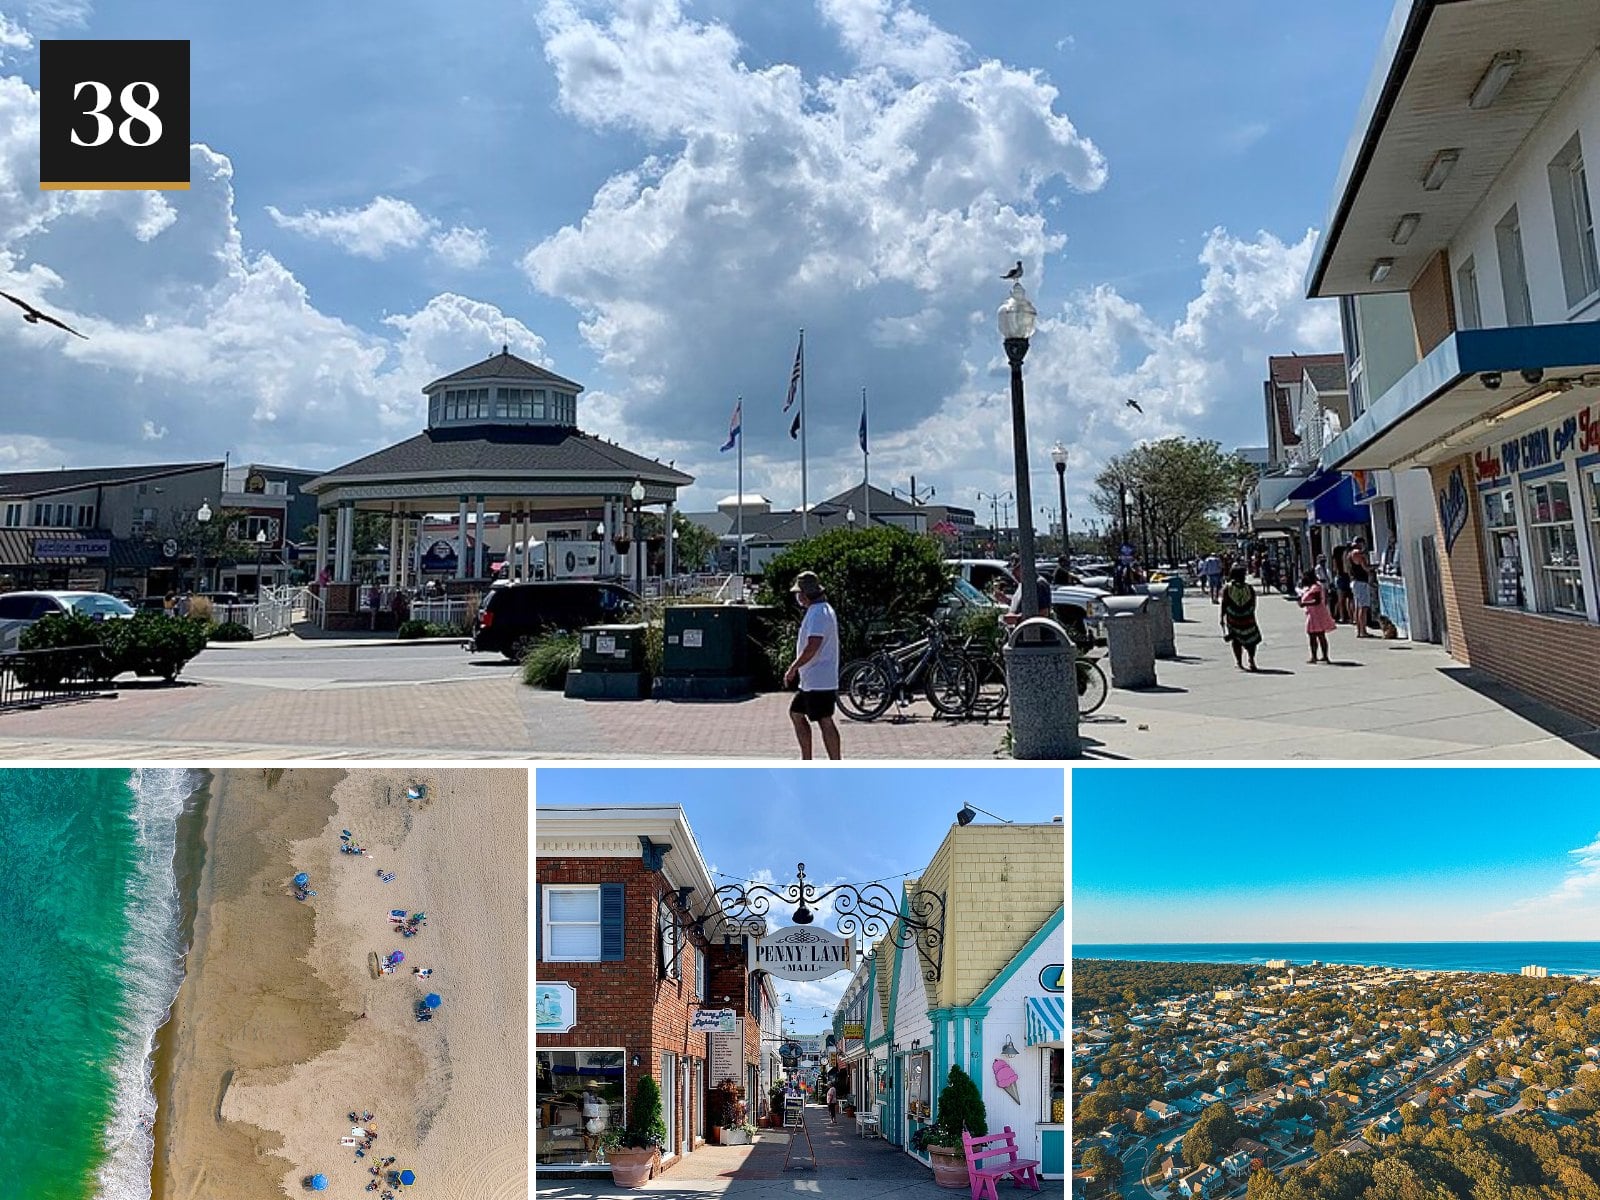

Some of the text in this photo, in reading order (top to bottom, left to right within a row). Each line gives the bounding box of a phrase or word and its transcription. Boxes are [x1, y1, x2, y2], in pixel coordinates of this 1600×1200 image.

[1501, 439, 1520, 475] POP
[756, 945, 850, 962] PENNY LANE
[787, 963, 819, 972] MALL
